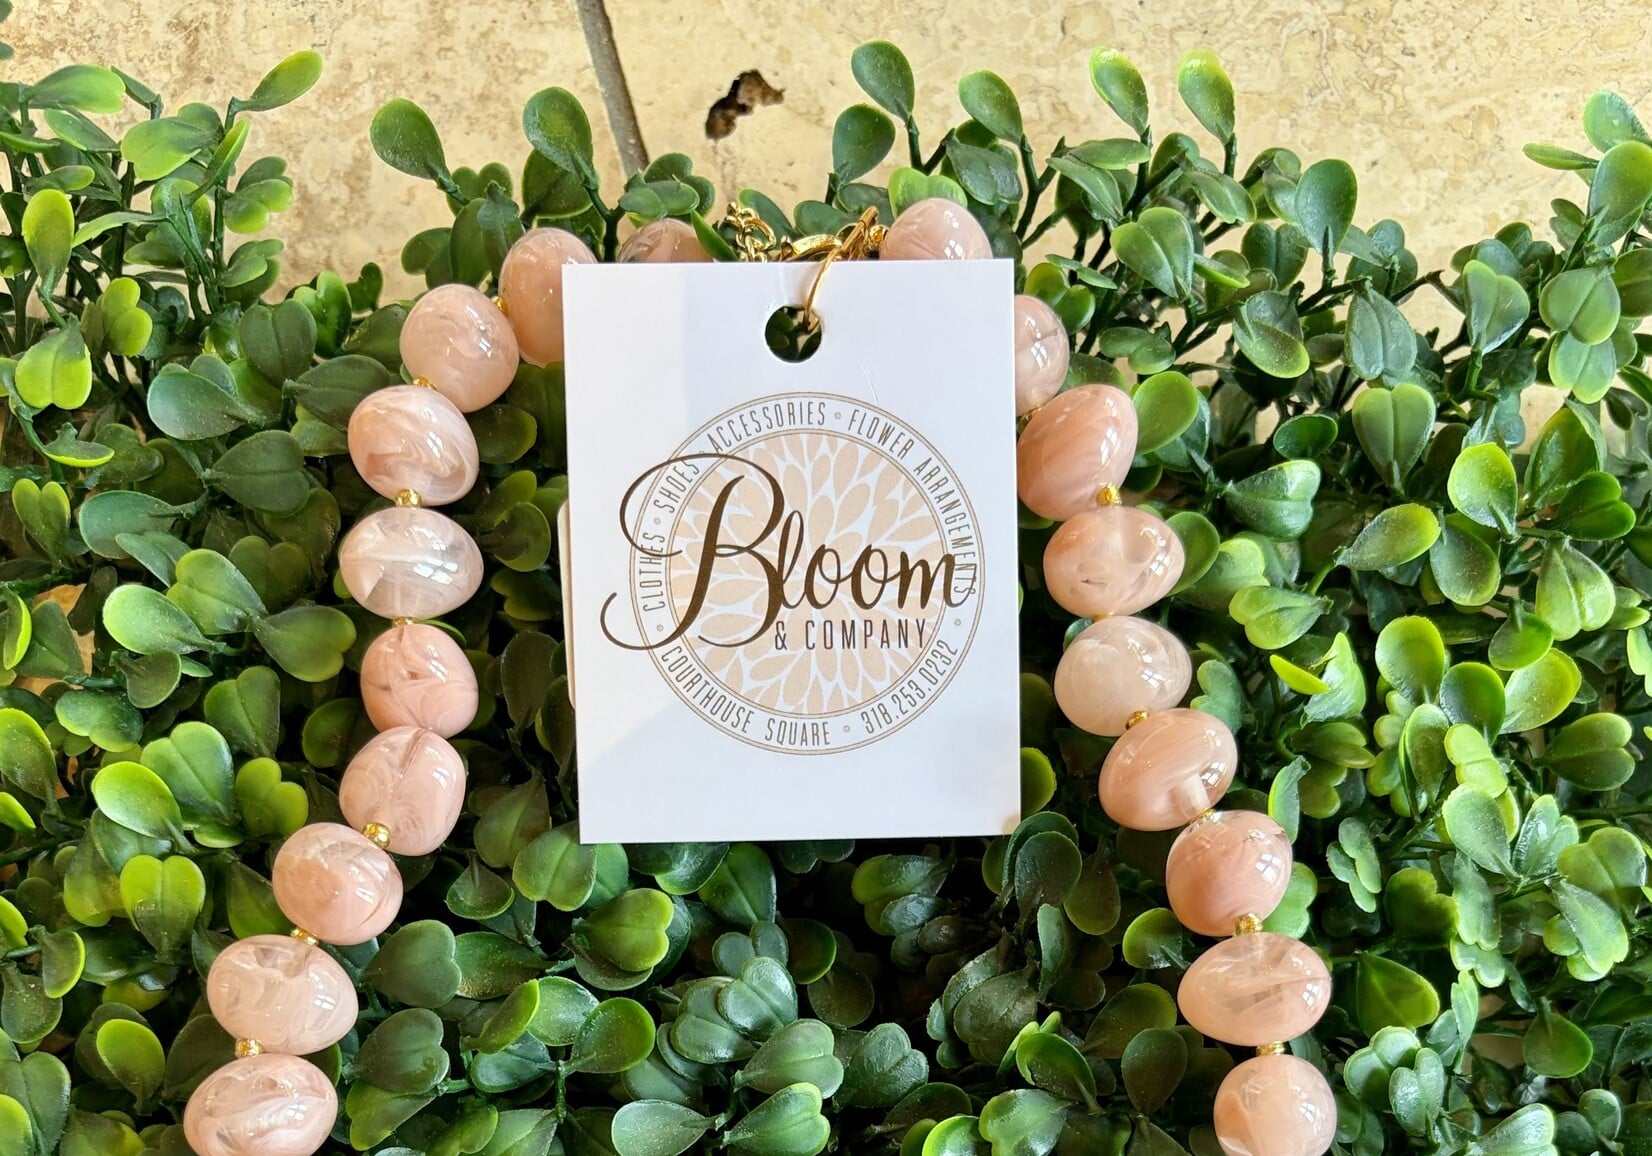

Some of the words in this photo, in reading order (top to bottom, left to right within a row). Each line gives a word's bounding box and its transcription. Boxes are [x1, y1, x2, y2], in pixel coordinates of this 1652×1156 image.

[706, 401, 826, 455] ACCESSORIES
[654, 459, 700, 514] SHOES
[848, 408, 914, 459] FLOWER
[913, 457, 977, 596] ARRANGEMENTS
[600, 453, 977, 650] Bloom
[639, 532, 665, 612] CLOTHES
[775, 620, 787, 650] &
[805, 618, 926, 650] COMPANY
[661, 645, 754, 734] COURTHOUSE
[765, 717, 831, 747] SQUARE
[860, 639, 959, 735] 318.253.0232
